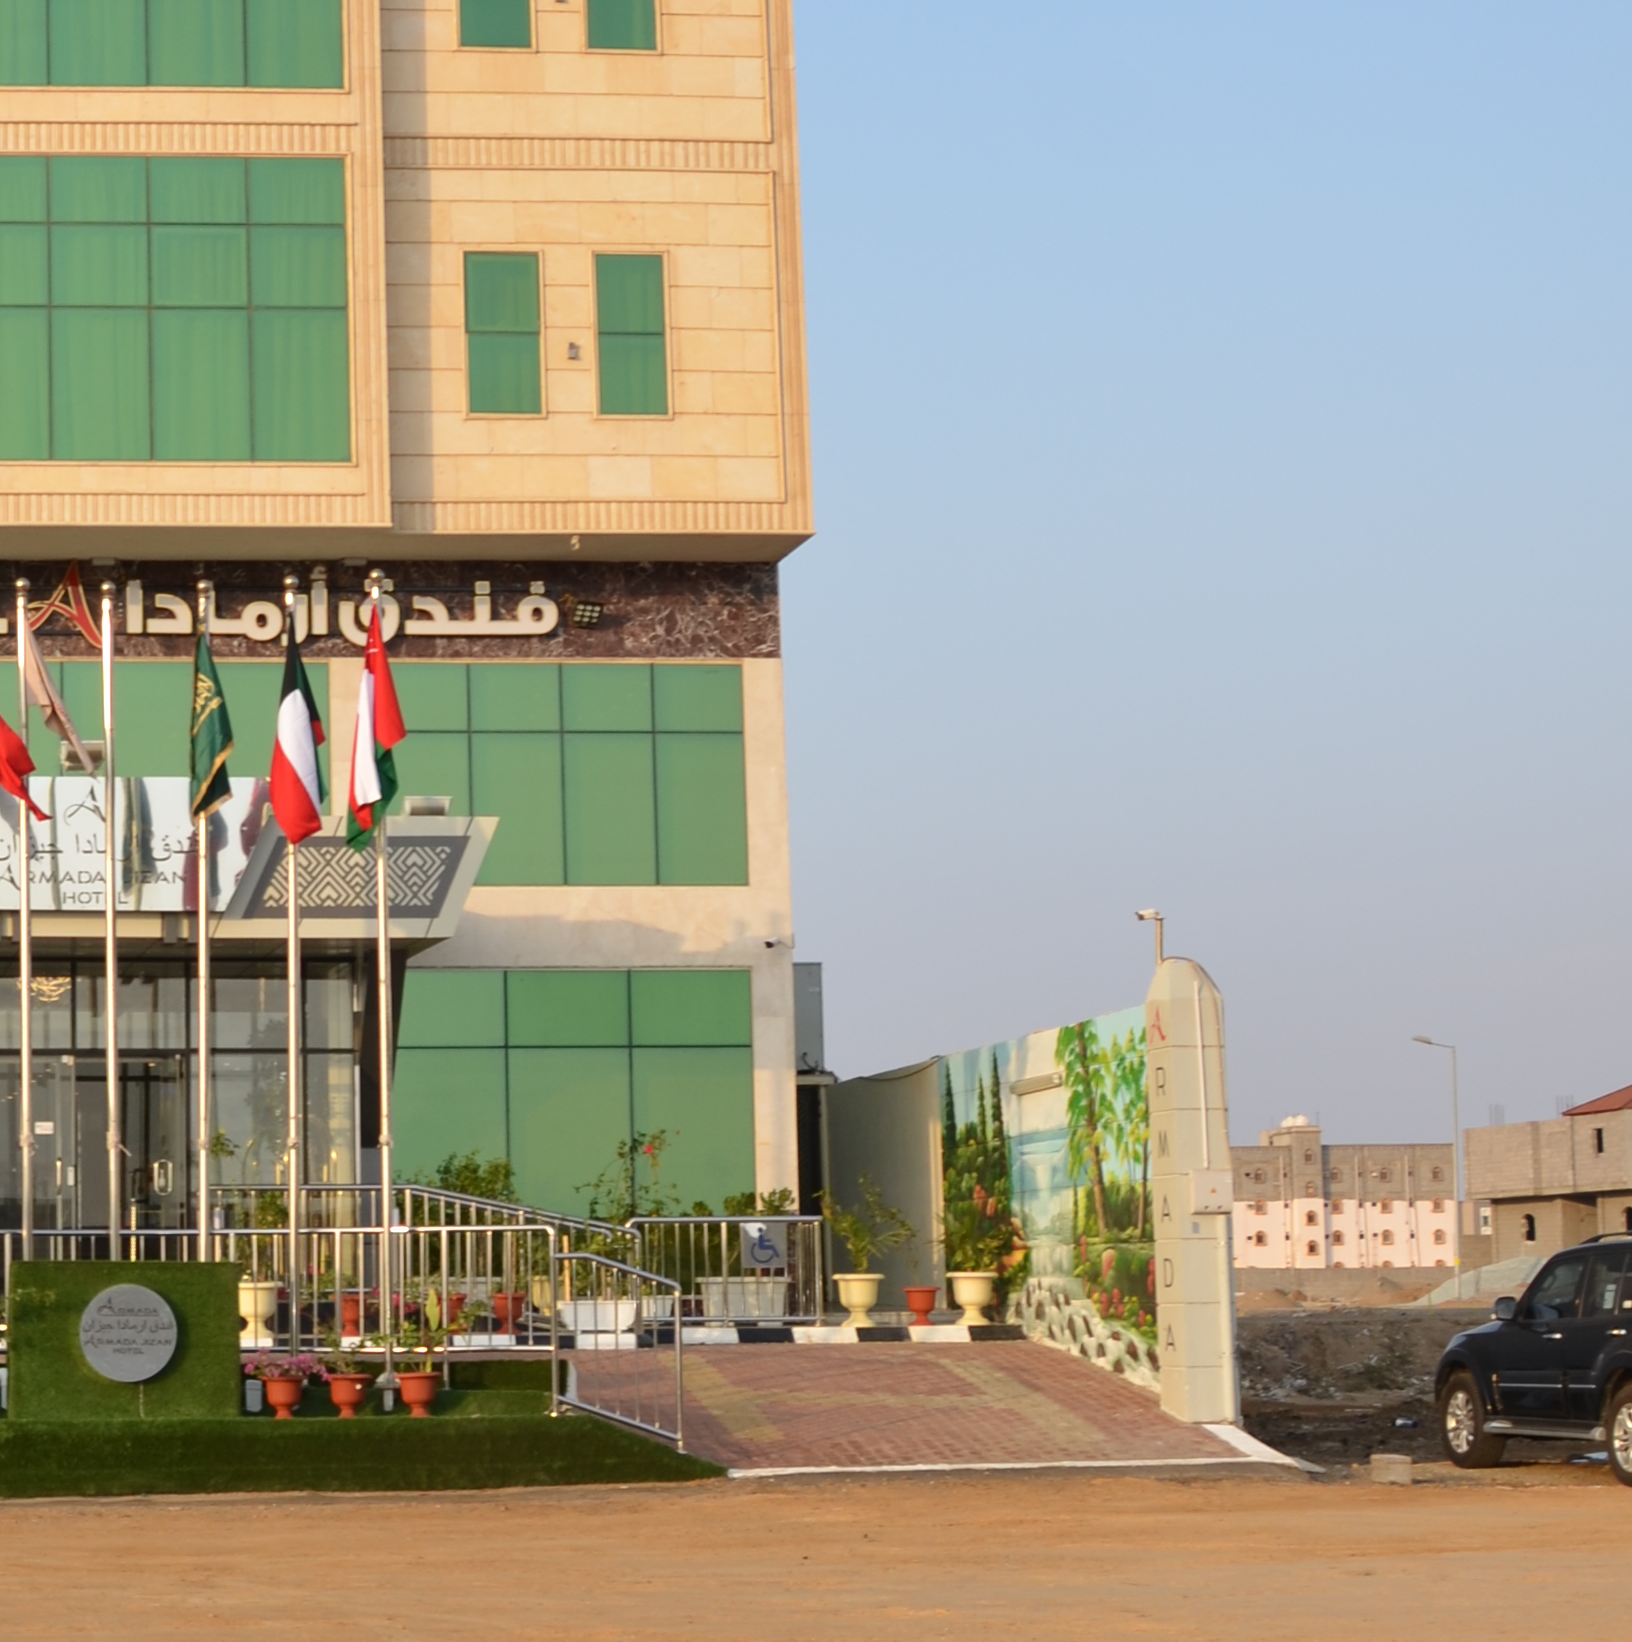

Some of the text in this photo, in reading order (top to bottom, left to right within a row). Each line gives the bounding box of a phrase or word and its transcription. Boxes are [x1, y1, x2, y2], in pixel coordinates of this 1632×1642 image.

[338, 579, 559, 647] فندق
[62, 891, 129, 905] HOTL
[1149, 1006, 1177, 1353] ARMADA
